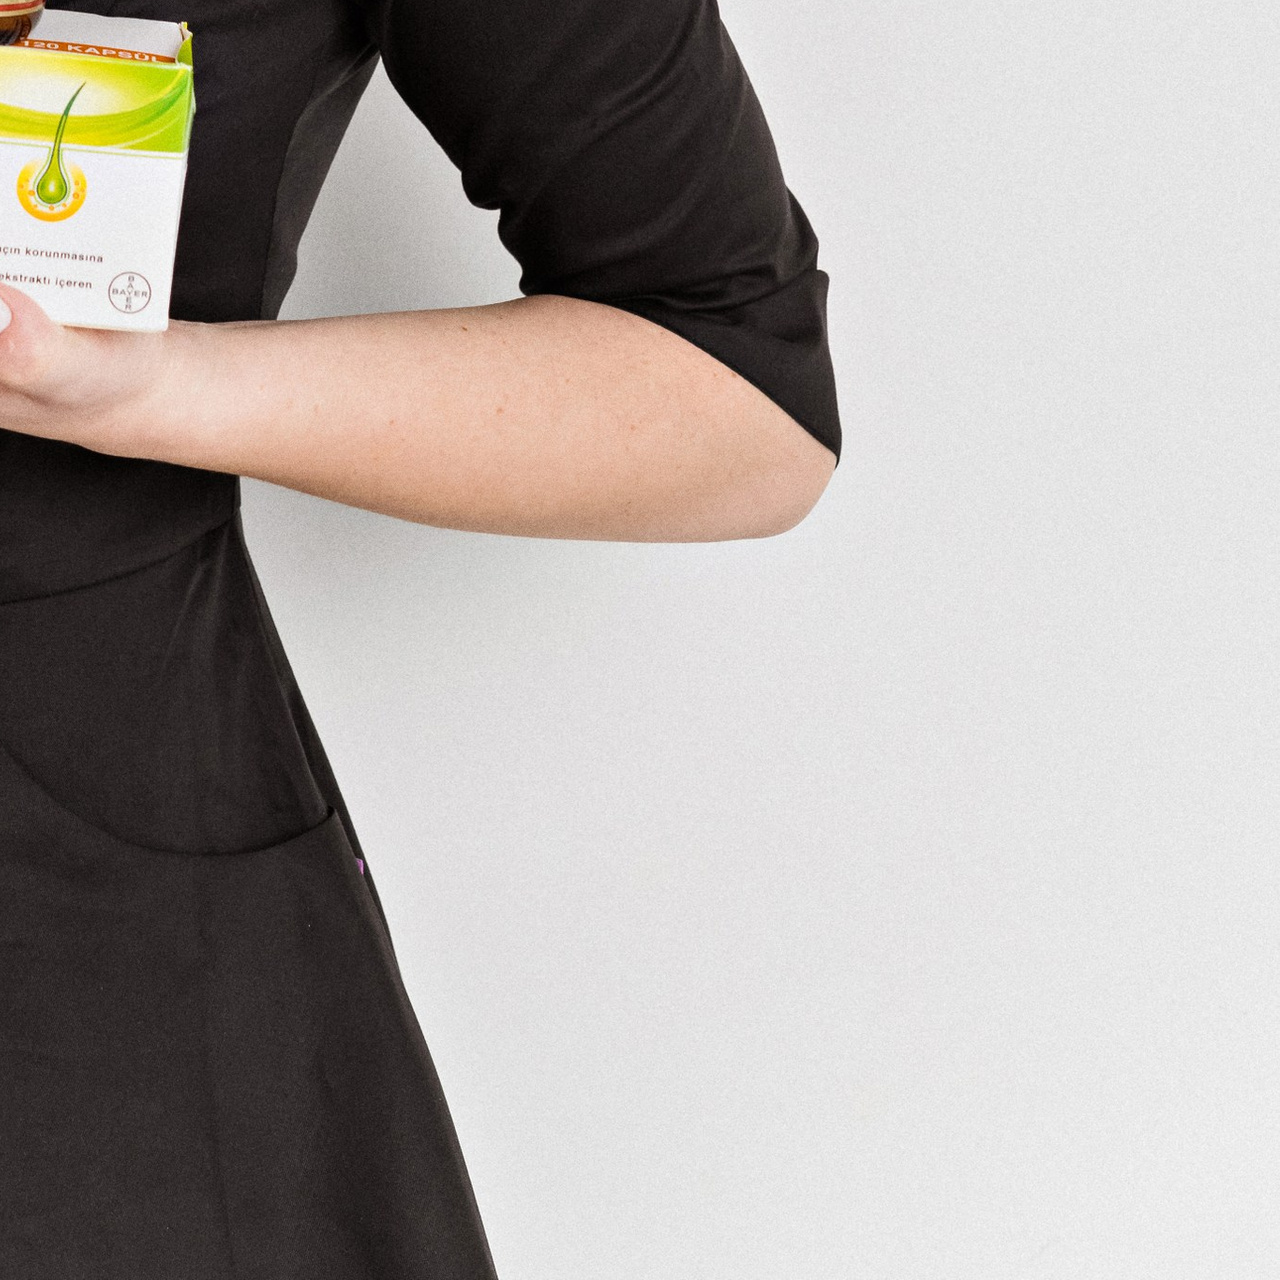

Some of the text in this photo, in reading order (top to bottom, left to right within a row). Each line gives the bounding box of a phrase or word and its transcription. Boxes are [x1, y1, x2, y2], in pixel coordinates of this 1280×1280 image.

[22, 40, 160, 63] 120 KAPSÜL
[25, 247, 104, 263] korunmasına
[55, 277, 93, 289] içeren
[111, 288, 148, 299] BAYER
[124, 275, 135, 311] BAYER
